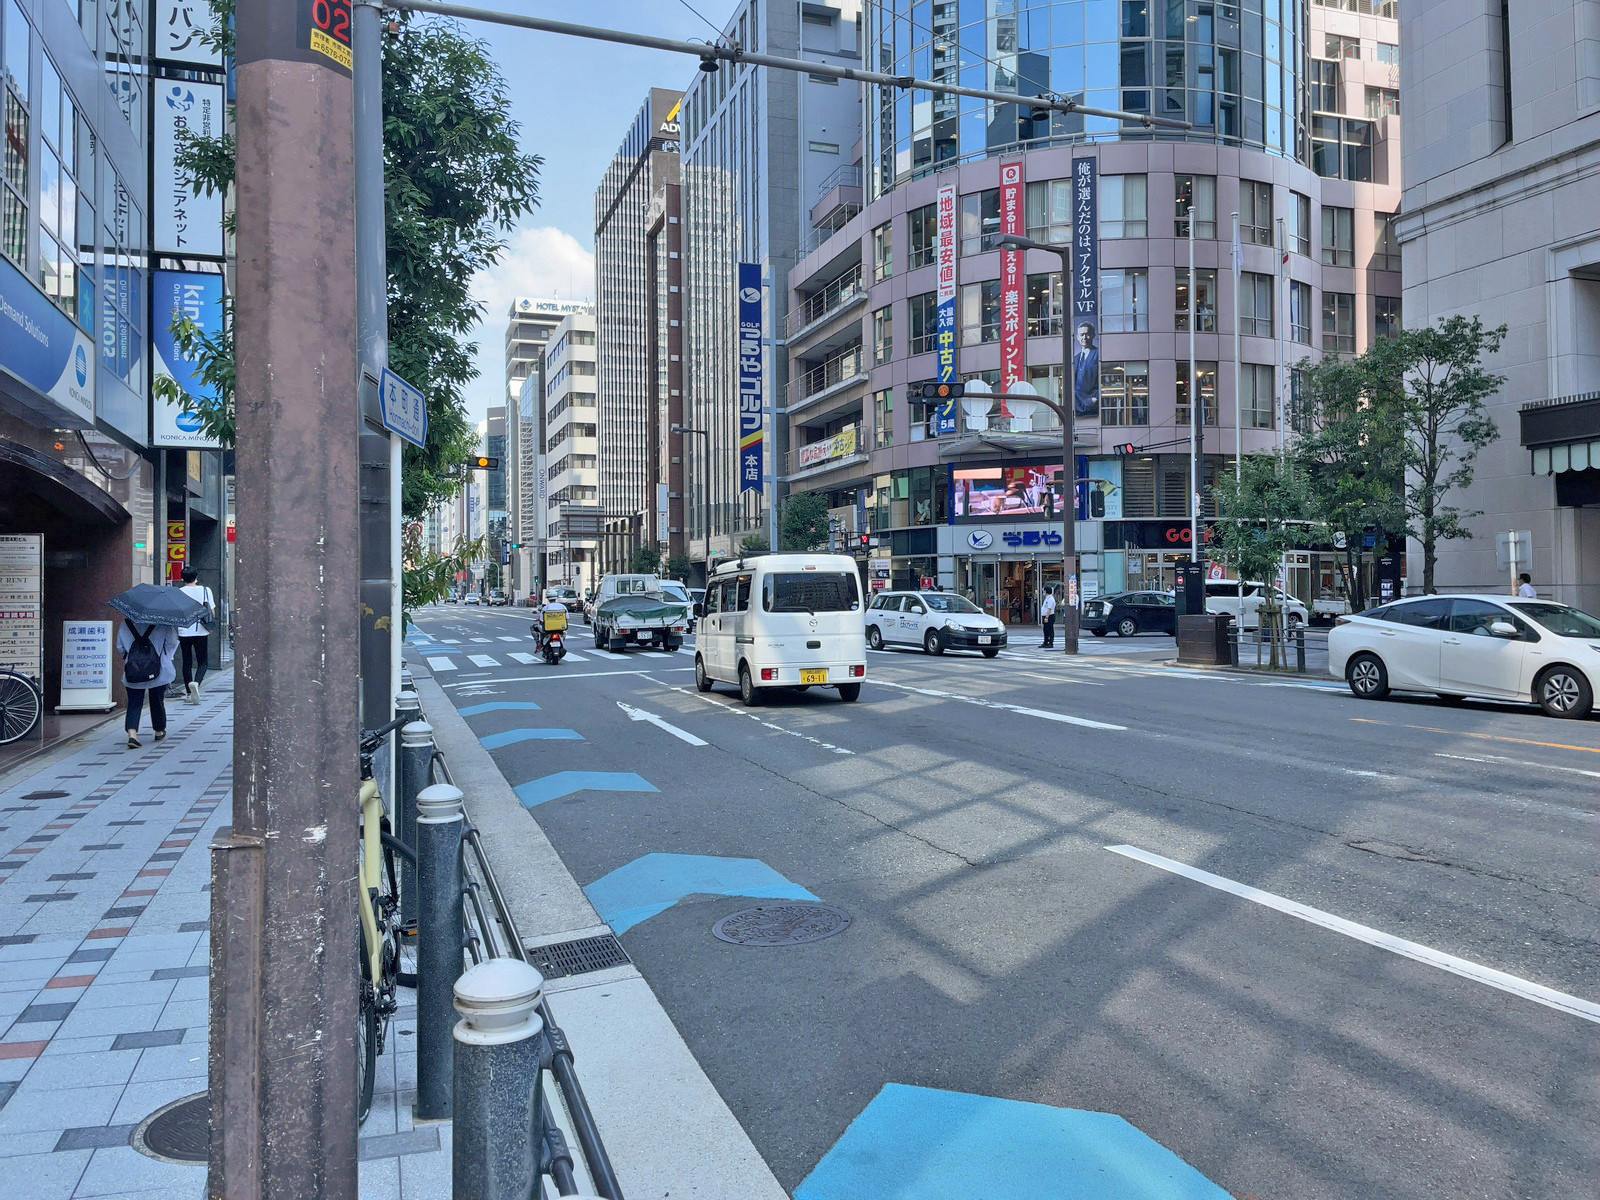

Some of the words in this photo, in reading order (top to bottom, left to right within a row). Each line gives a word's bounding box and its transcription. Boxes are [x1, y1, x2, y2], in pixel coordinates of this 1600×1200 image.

[168, 0, 193, 51] バン
[174, 115, 187, 247] おおさシニアネット
[536, 302, 559, 311] HOTEL
[1077, 301, 1095, 312] VF
[939, 330, 954, 416] 中古クブ
[160, 433, 187, 441] KONICA
[744, 454, 758, 481] 本店
[1166, 528, 1215, 543] GOF
